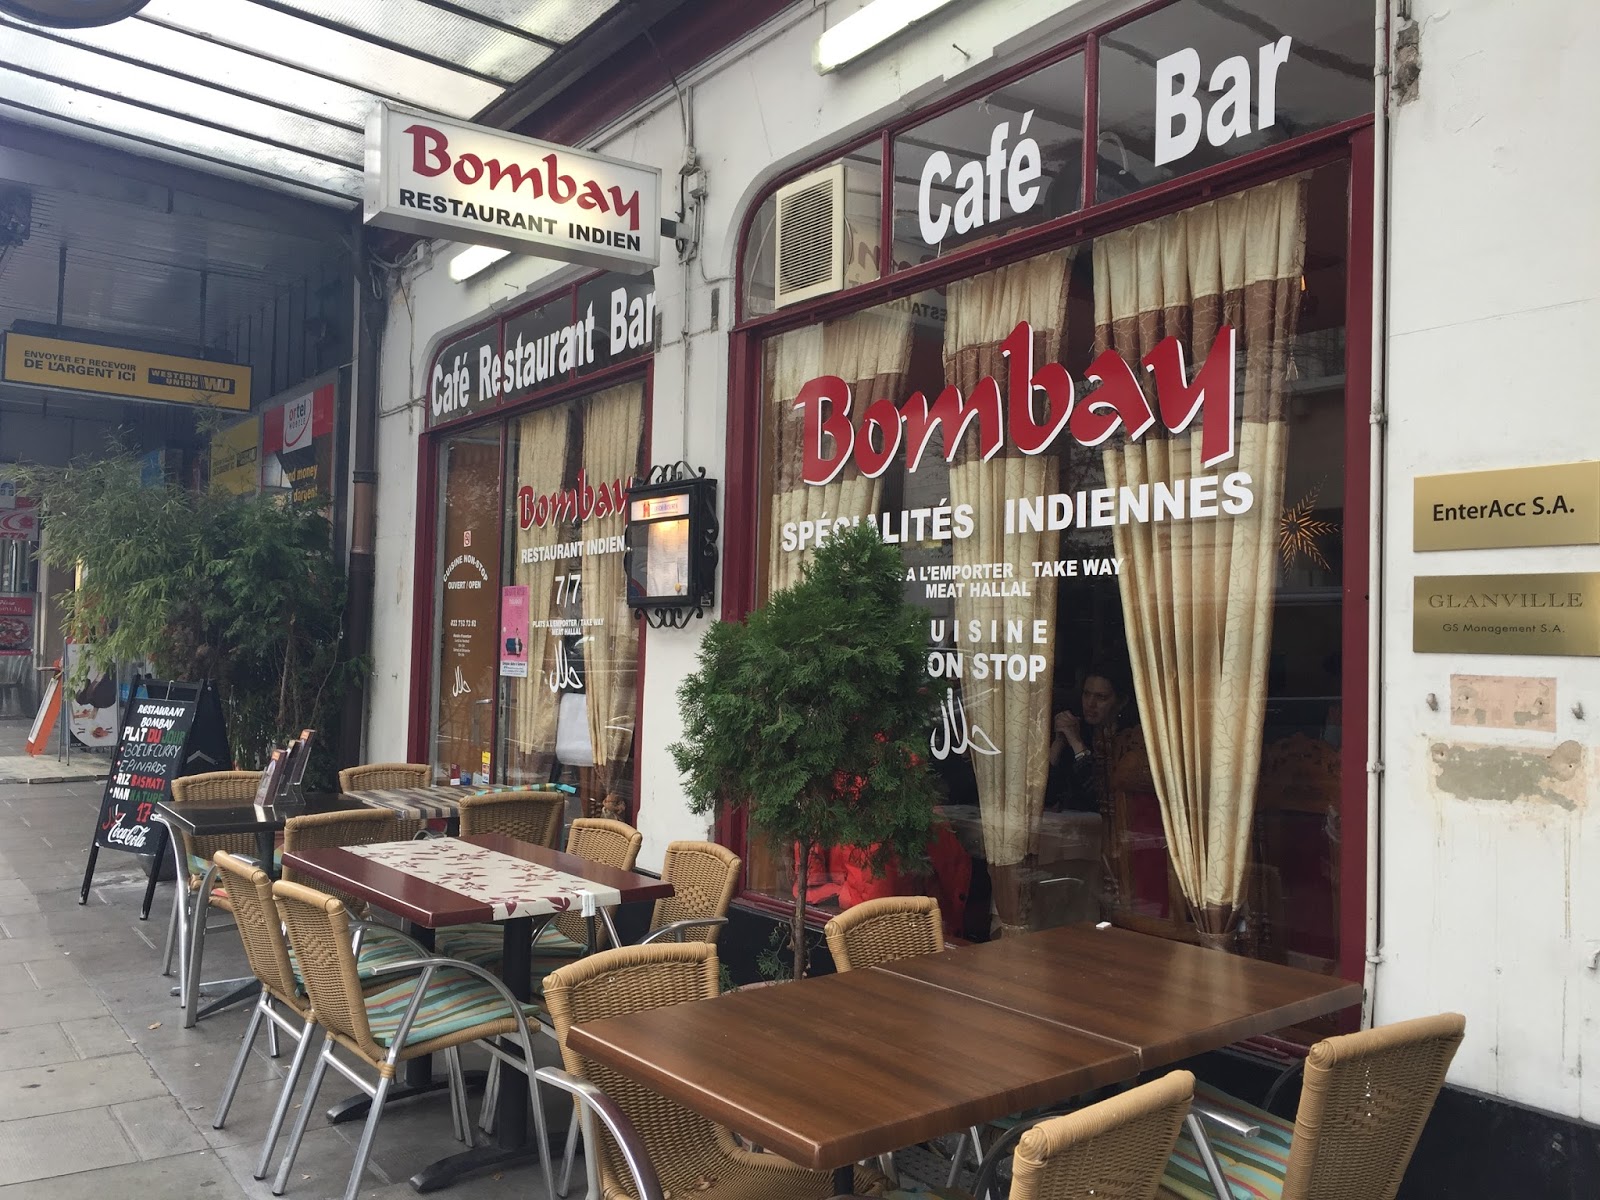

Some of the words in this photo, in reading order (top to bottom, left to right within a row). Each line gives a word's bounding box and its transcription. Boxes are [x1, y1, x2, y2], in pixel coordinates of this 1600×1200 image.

[918, 109, 1042, 246] Café
[1154, 35, 1292, 167] Bar
[403, 124, 640, 231] Bombay
[400, 188, 557, 235] RESTAURANT
[568, 222, 640, 252] INDIEN
[24, 350, 71, 363] ENVOYER
[74, 356, 87, 364] ET
[89, 358, 136, 371] RECEVOIR
[431, 351, 470, 416] Café
[479, 300, 595, 401] Restaurant
[610, 287, 656, 355] Bar
[24, 358, 43, 370] DE
[48, 361, 114, 378] L'ARGENT
[118, 371, 136, 382] ICI
[151, 369, 199, 382] WESTERN
[203, 376, 230, 392] WU
[165, 378, 199, 388] UNION
[289, 399, 306, 421] ortel
[793, 320, 1236, 486] Bombay
[518, 466, 633, 531] Bombay
[1006, 472, 1254, 534] INDIENNES
[1433, 500, 1526, 522] EnterAcc
[1532, 495, 1575, 516] S.A.
[521, 541, 584, 564] RESTAURANT
[586, 535, 625, 556] INDIEN
[443, 555, 463, 582] CUISINE
[906, 566, 917, 582] A
[920, 562, 1013, 582] L'EMPORTER
[1032, 560, 1078, 578] TAKE
[1082, 558, 1125, 576] WAY
[448, 581, 466, 590] OUVERT
[468, 581, 482, 589] OPEN
[555, 572, 581, 608] 7/7
[926, 583, 965, 599] MEAT
[970, 582, 1031, 598] HALLAL
[1428, 592, 1583, 608] GLANVILLE
[1442, 623, 1459, 632] GS
[1463, 622, 1536, 635] Management
[1541, 622, 1565, 633] S.A.
[972, 653, 1047, 682] STOP
[137, 704, 185, 718] RESTAURANT
[122, 726, 148, 742] PLAT
[147, 728, 162, 743] DU
[161, 730, 186, 745] JOUR
[140, 717, 175, 731] BOMBAY
[118, 759, 167, 775] EPINARDS
[116, 773, 132, 786] RIZ
[131, 774, 165, 791] BASMATI
[112, 787, 131, 801] NAN
[136, 802, 152, 823] 17
